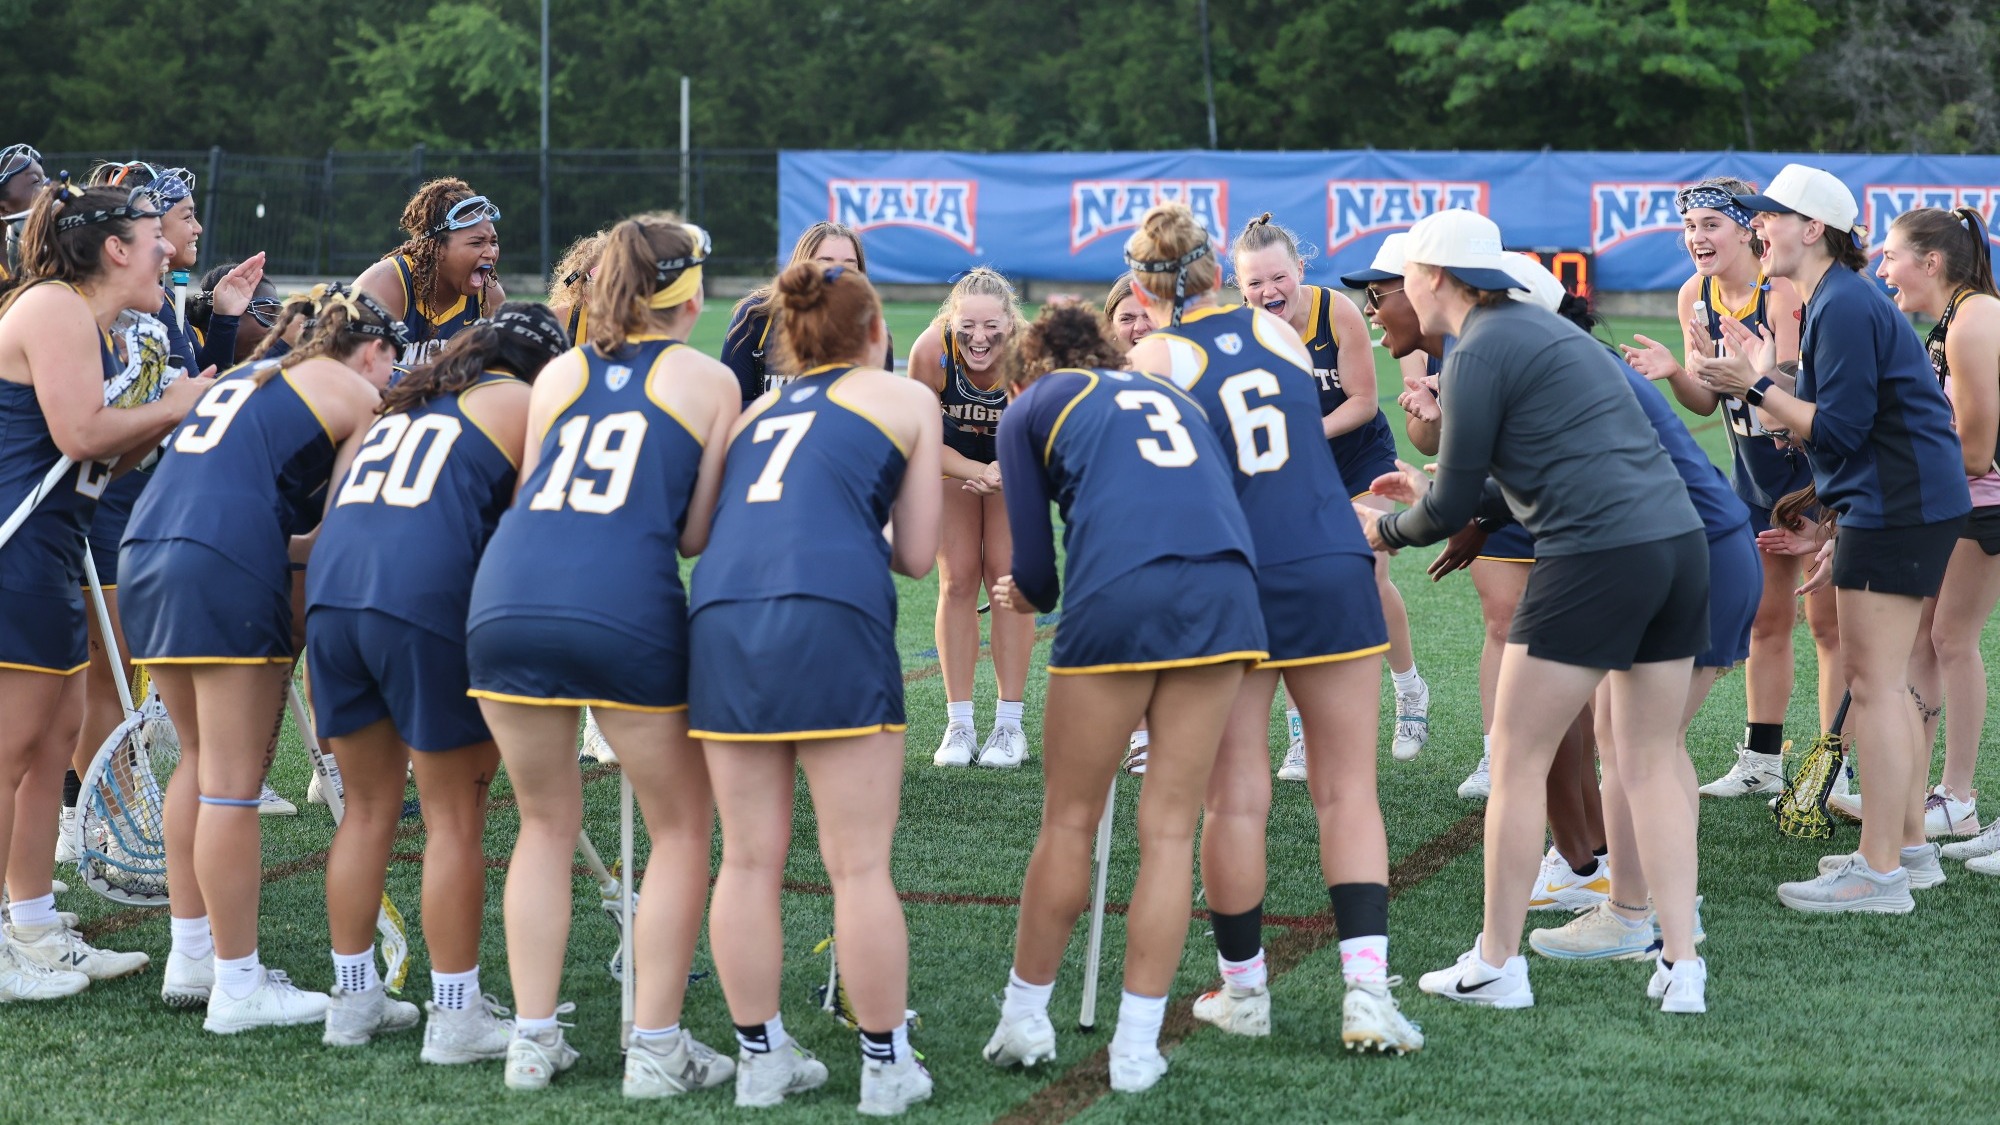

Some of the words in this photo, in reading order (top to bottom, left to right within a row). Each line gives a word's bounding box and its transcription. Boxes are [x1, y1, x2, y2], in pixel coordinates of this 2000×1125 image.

[830, 180, 977, 250] NAIA
[361, 324, 386, 335] STX
[364, 298, 387, 320] STX
[500, 311, 533, 324] STX
[512, 325, 544, 344] STX
[540, 320, 564, 345] STX
[174, 379, 257, 453] 9
[941, 403, 1003, 422] NIGH
[1114, 390, 1199, 468] 3
[1218, 368, 1290, 477] 6
[336, 412, 463, 508] 20
[529, 410, 649, 515] 19
[746, 410, 817, 503] 7
